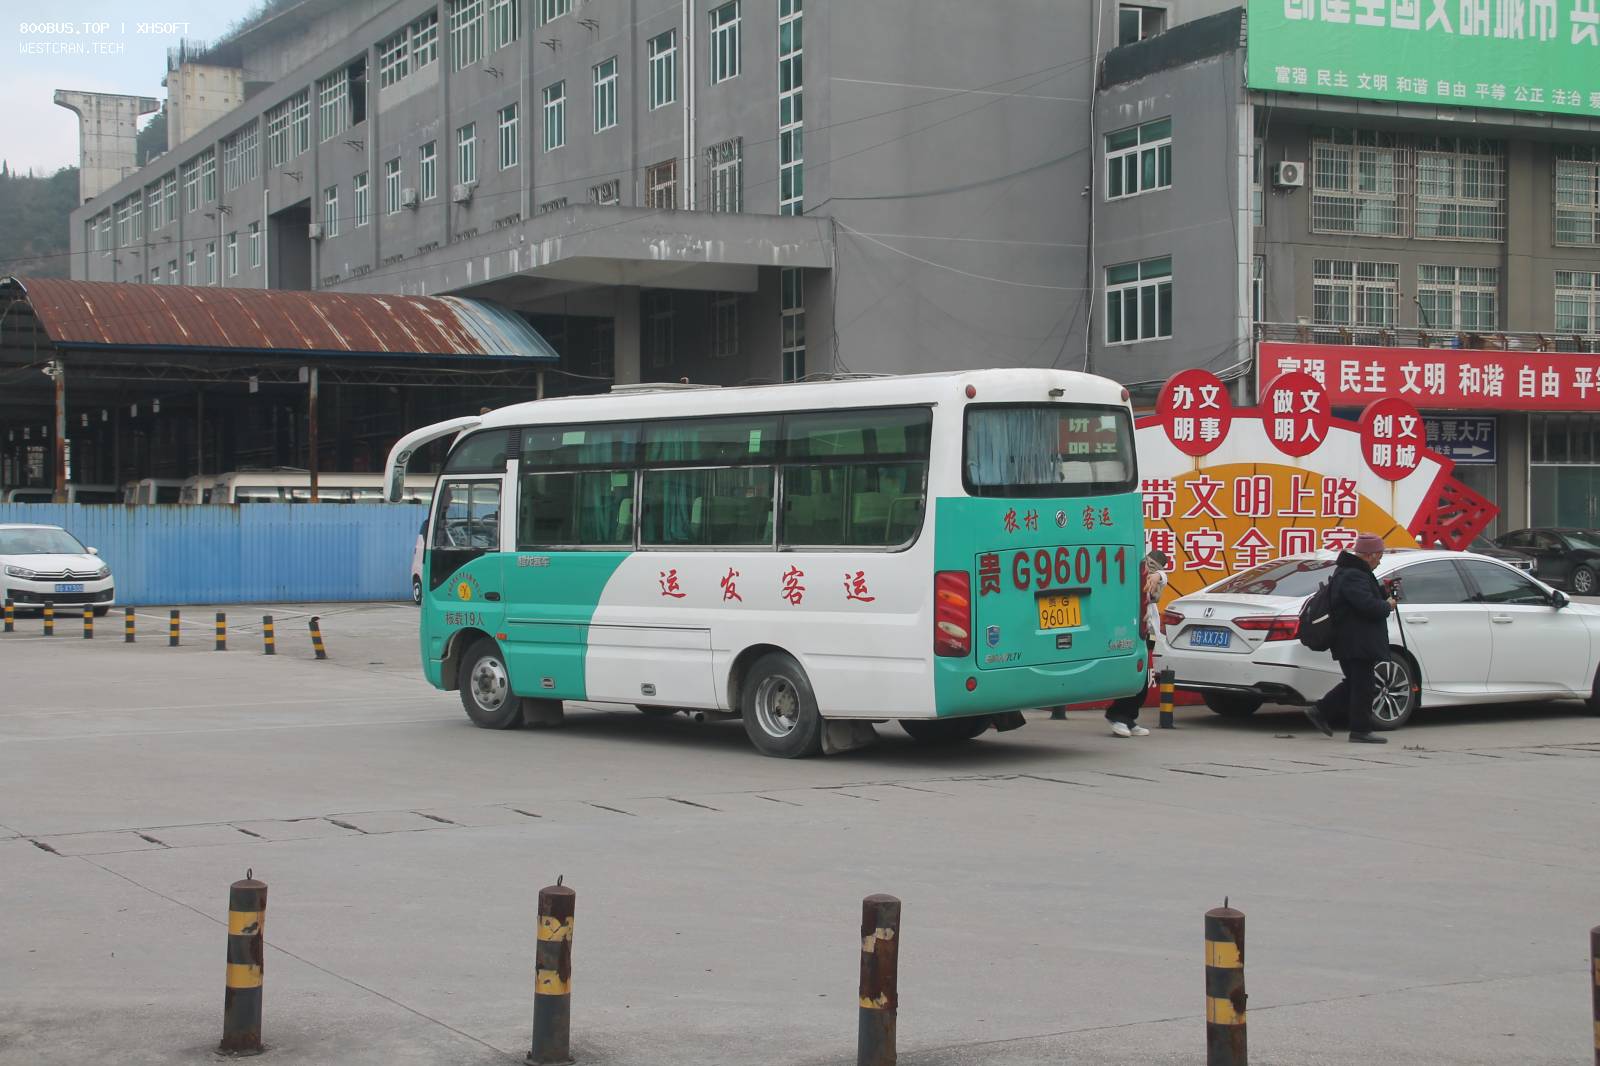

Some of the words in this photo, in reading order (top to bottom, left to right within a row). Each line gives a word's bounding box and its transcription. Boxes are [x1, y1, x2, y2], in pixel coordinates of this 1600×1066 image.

[1275, 66, 1308, 85] 富强
[1317, 69, 1349, 88] 民主
[1357, 72, 1388, 91] 文明
[1396, 76, 1429, 95] 和谐
[1437, 79, 1466, 98] 自由
[1475, 82, 1506, 101] 平等
[1514, 86, 1545, 103] 公正
[1552, 89, 1581, 107] 法治
[1340, 359, 1387, 393] 民主
[1400, 360, 1446, 395] 文明
[1458, 363, 1505, 397] 和谐
[1518, 364, 1560, 398] 自由
[1572, 366, 1600, 399] 平
[1172, 384, 1220, 410] 办文
[1272, 389, 1320, 414] 做文
[1173, 417, 1221, 442] 明事
[1274, 418, 1320, 443] 明人
[1373, 413, 1418, 438] 创文
[1425, 420, 1491, 442] 售票大厅
[1372, 443, 1417, 469] 明城
[1140, 474, 1359, 520] 带文明上路
[1003, 507, 1039, 534] 农村
[1082, 505, 1114, 532] 客运
[979, 553, 1001, 596] 贵
[1012, 546, 1126, 591] G96011
[1041, 608, 1077, 628] 96011
